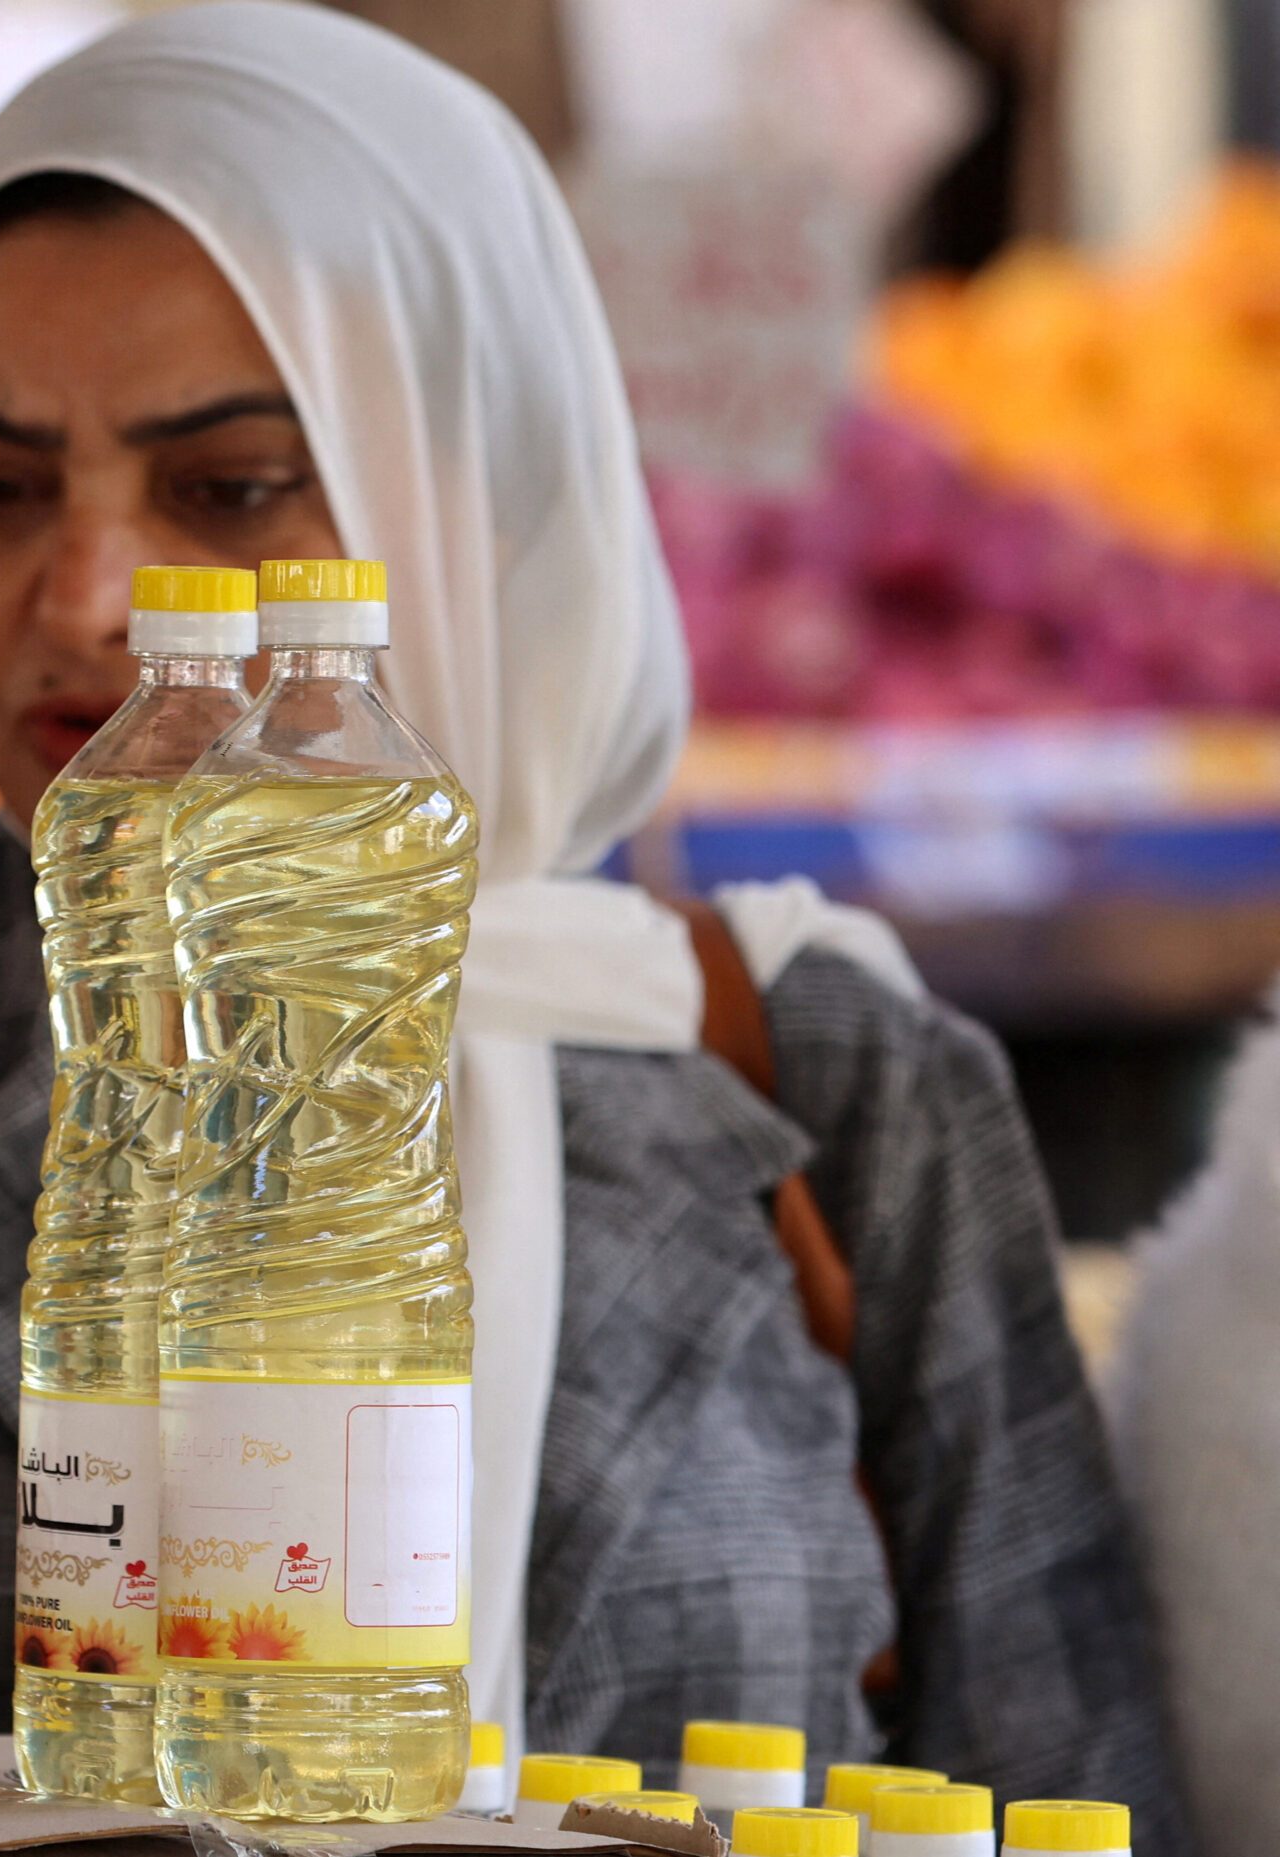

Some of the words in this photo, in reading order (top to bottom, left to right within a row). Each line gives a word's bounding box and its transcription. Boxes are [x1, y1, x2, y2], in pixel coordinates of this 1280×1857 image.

[287, 1560, 319, 1574] صديق
[287, 1574, 318, 1588] القلب
[35, 1596, 61, 1611] PURE
[54, 1617, 74, 1632] OIL
